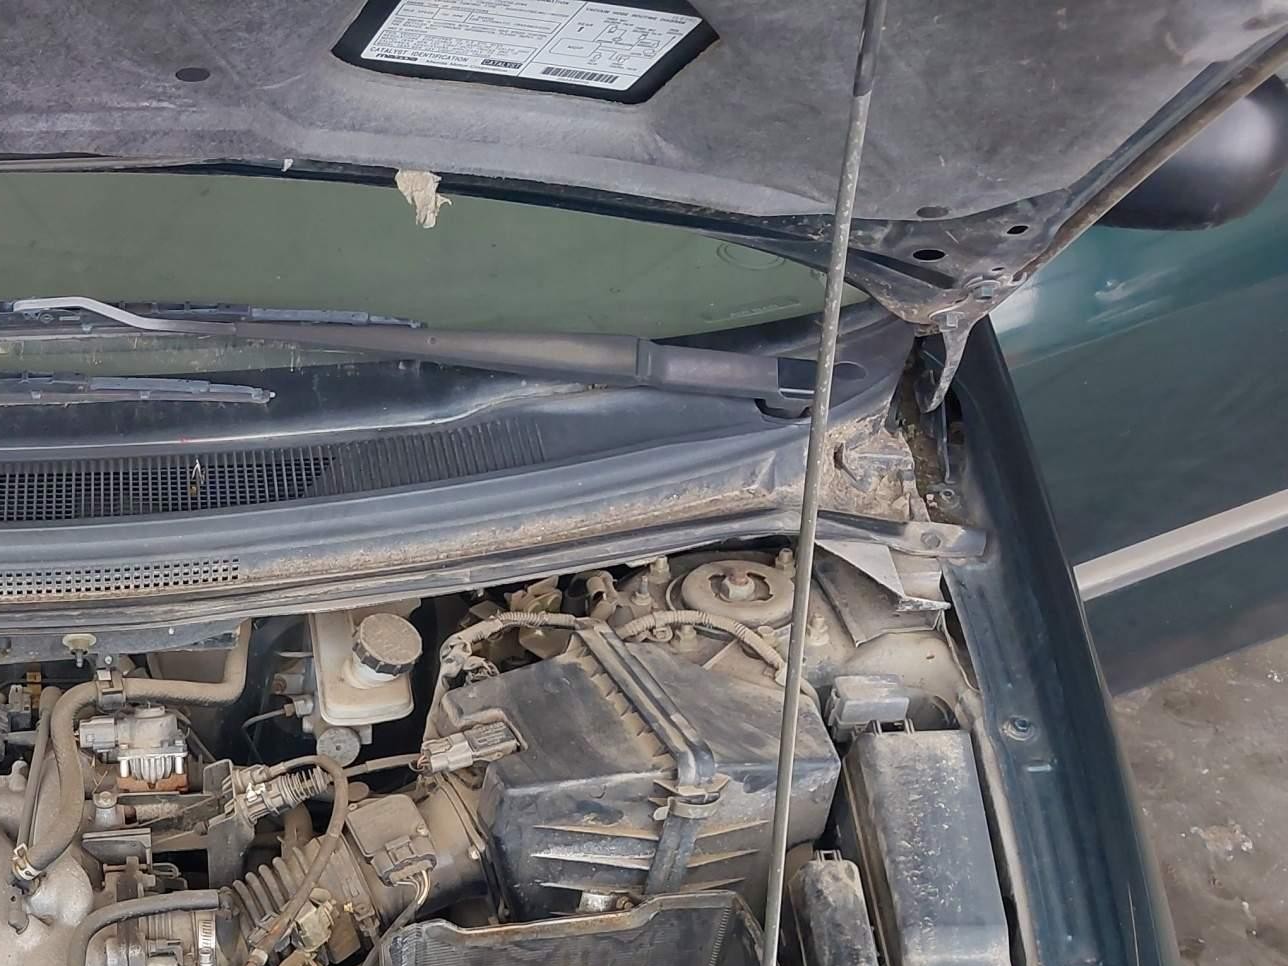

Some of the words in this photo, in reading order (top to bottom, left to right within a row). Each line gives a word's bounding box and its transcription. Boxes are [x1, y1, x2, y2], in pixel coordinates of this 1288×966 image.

[370, 46, 407, 56] CATALYST
[410, 50, 470, 63] IDENTIFICATION
[482, 59, 522, 69] CATALYST
